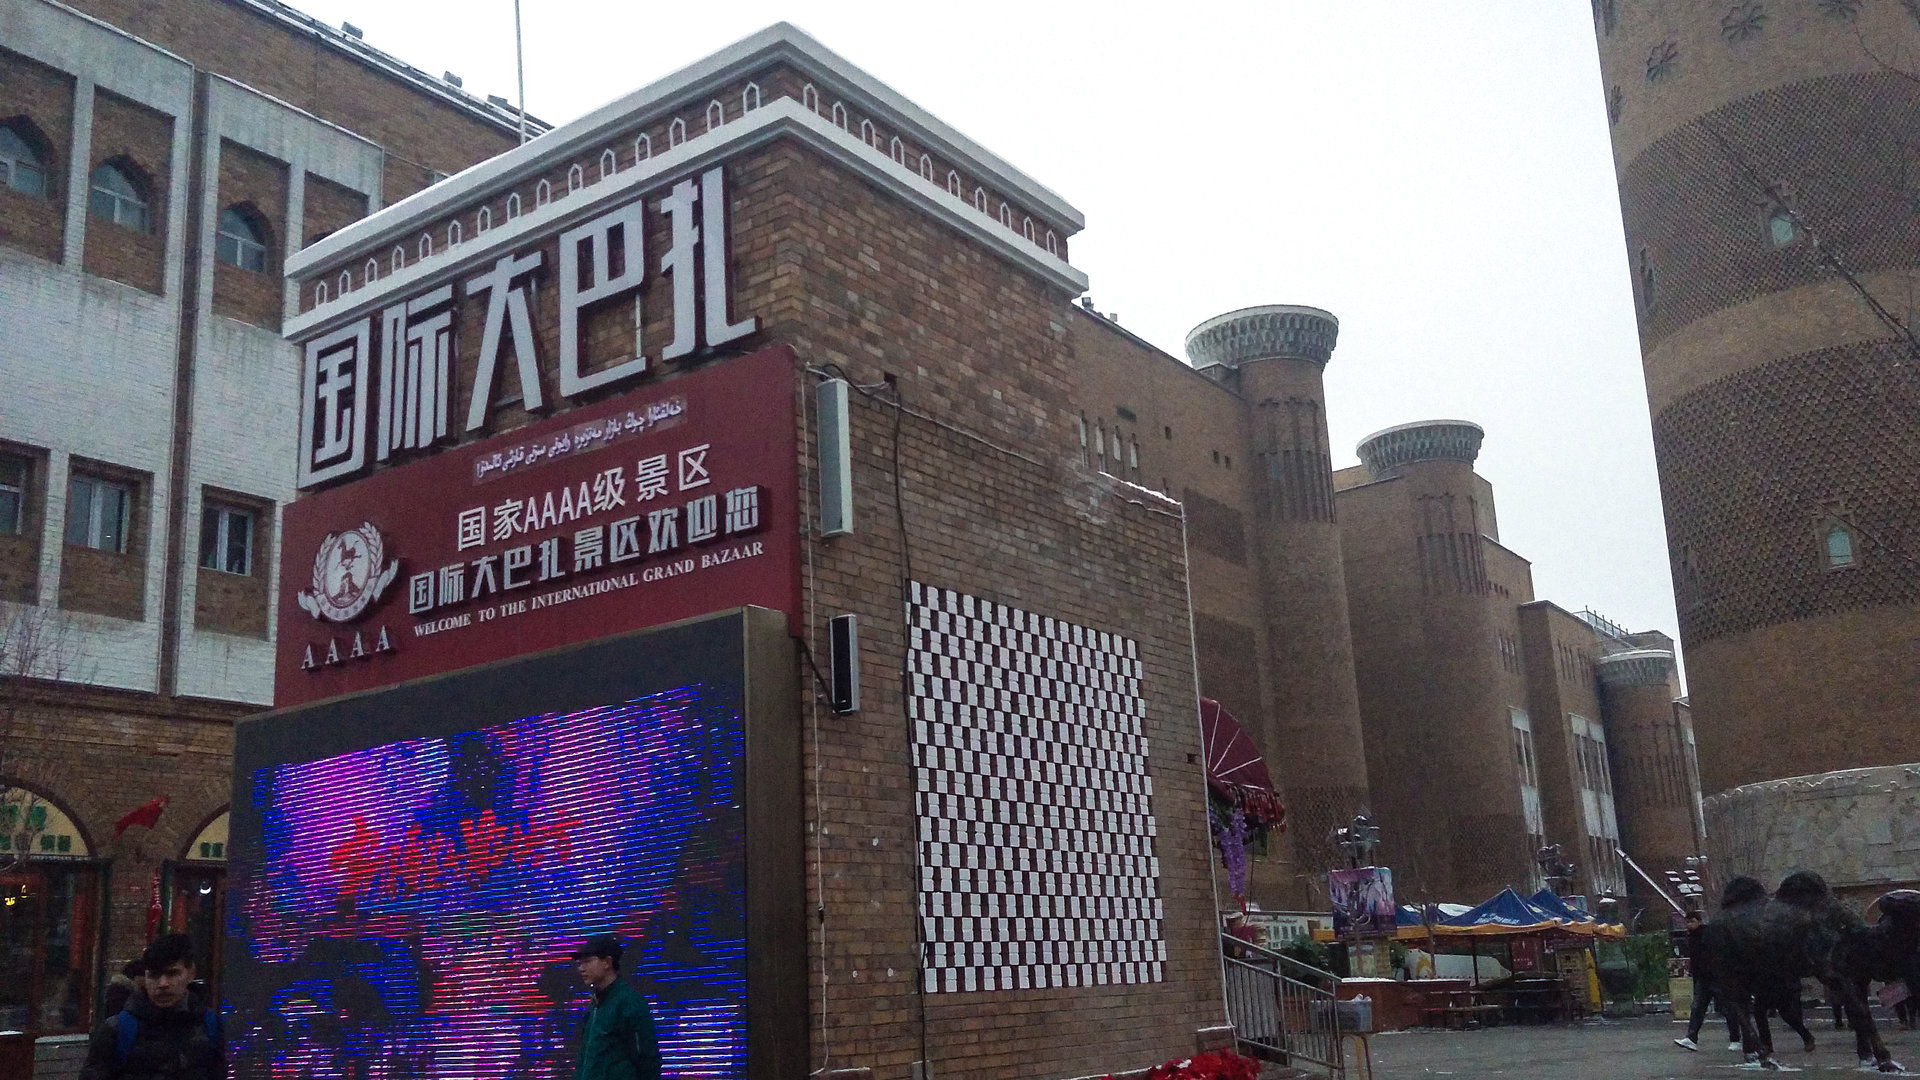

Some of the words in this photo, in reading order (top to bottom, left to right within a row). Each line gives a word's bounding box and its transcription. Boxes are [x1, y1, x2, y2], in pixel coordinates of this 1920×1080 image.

[299, 166, 756, 488] 国际大巴扎
[409, 485, 759, 615] 国际大巴扎景区欢迎您
[457, 444, 711, 552] 国家AAAA级景区
[414, 612, 472, 638] WELCOME
[478, 607, 495, 622] TO
[500, 599, 527, 617] THE
[532, 573, 639, 610] INTERNATIONAL
[643, 558, 695, 583] GRAND
[702, 541, 764, 570] BAZAAR
